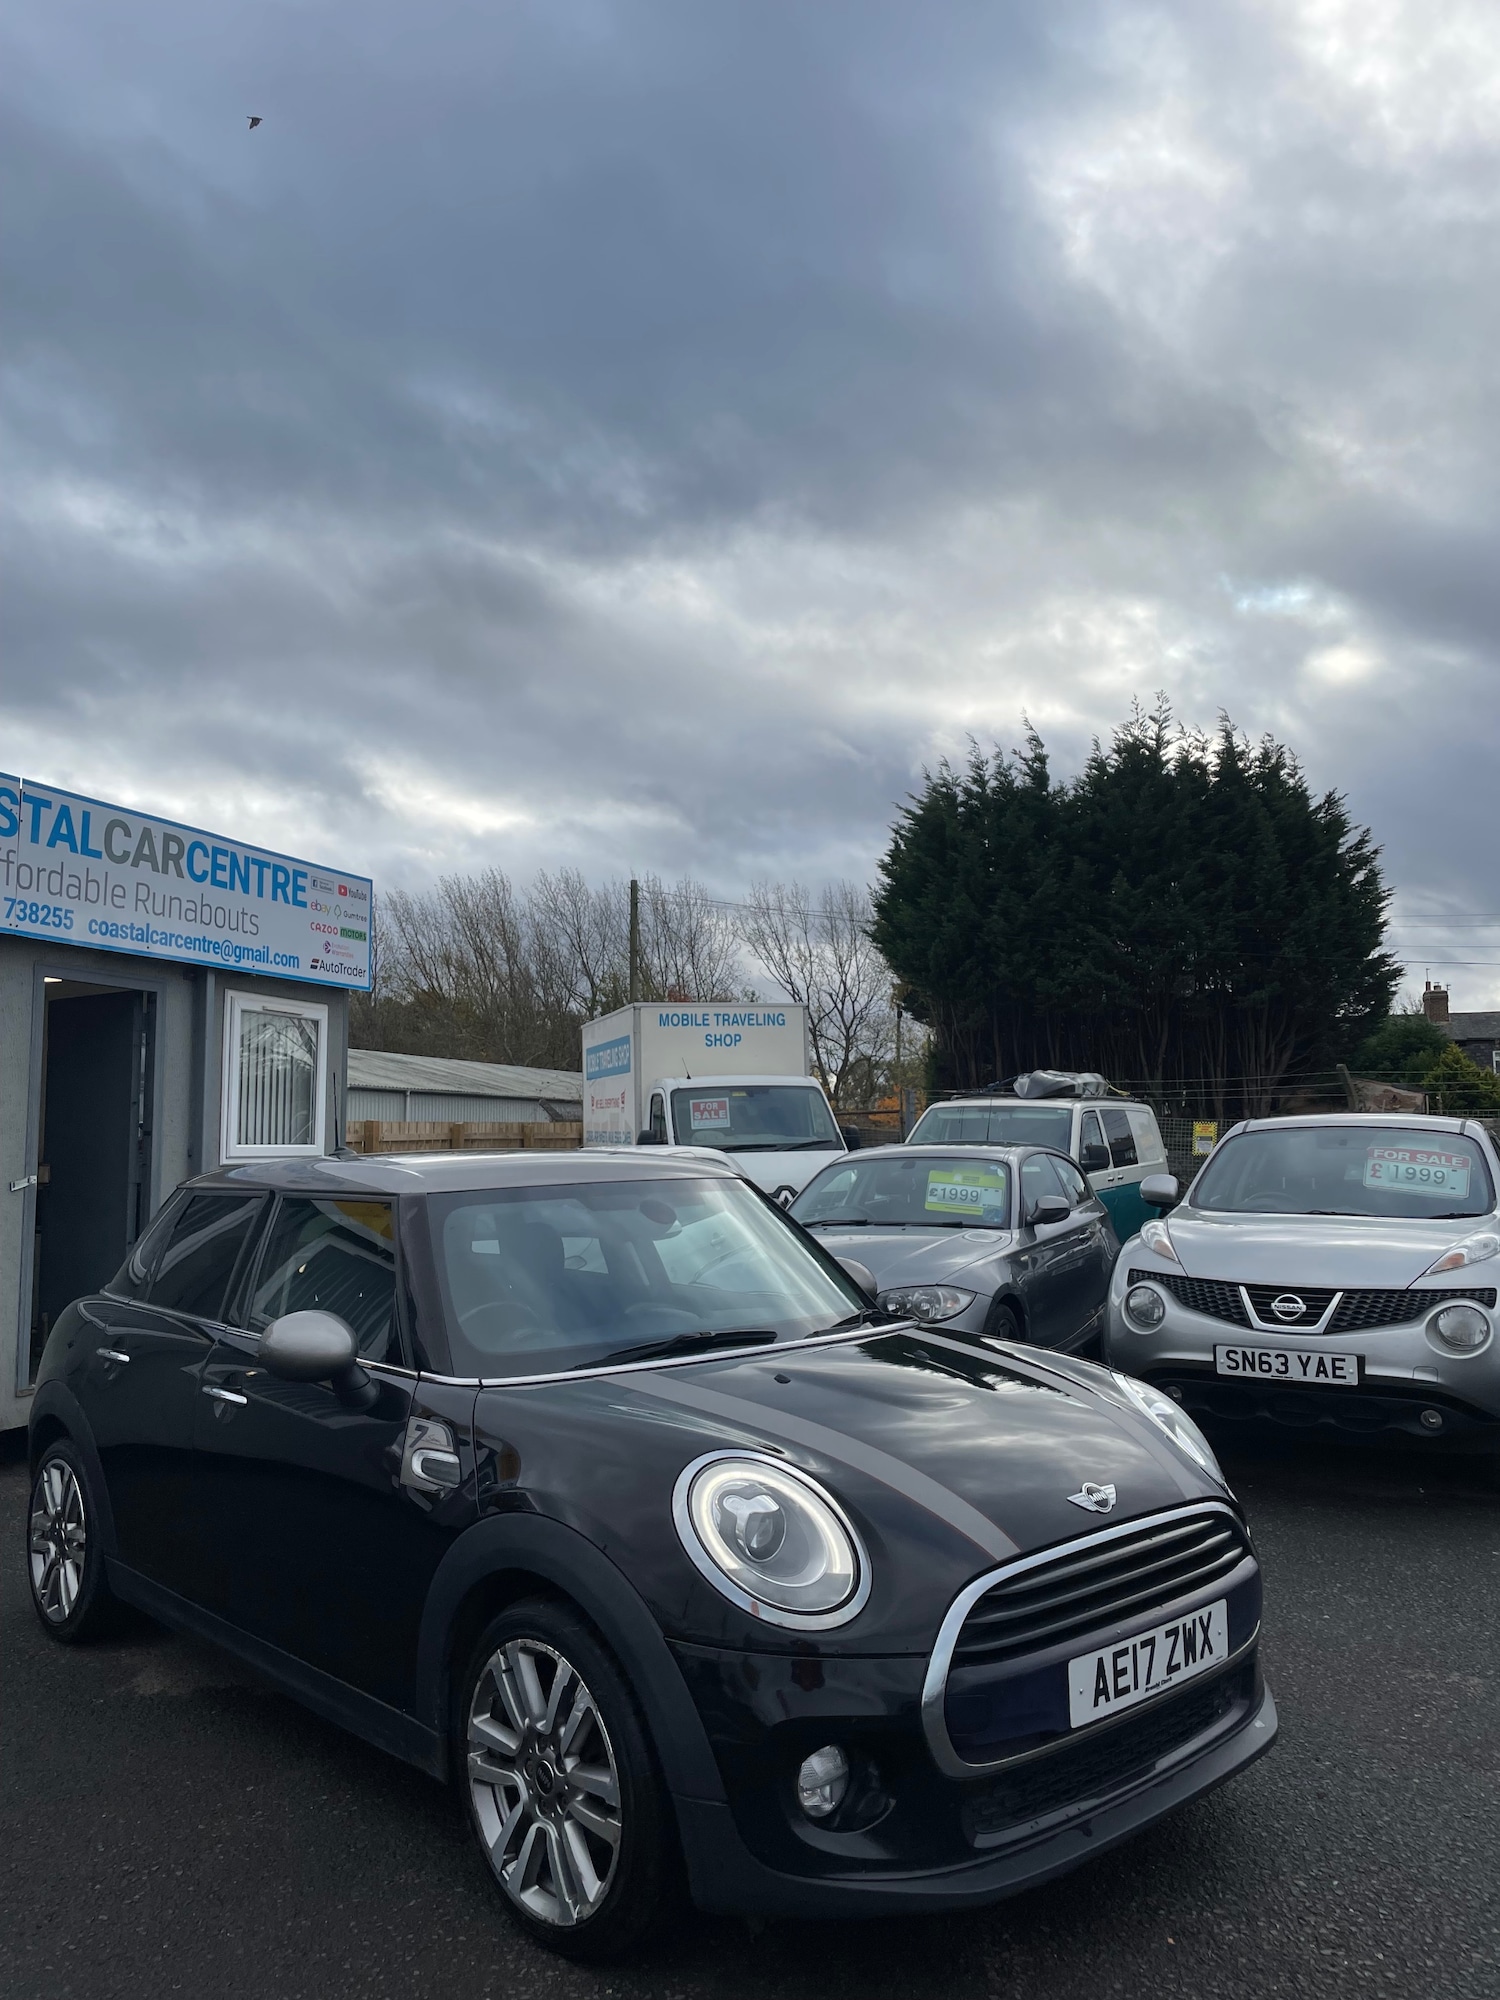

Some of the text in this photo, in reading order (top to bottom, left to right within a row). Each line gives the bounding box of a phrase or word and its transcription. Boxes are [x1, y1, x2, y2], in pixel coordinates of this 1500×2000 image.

[0, 848, 260, 935] fordable Runabouts
[348, 887, 367, 901] YouTube
[310, 899, 331, 917] ebay
[343, 911, 367, 922] Gumtree
[3, 897, 300, 969] 738255 coastalcarcentre@gmail.com
[310, 921, 338, 936] CAZOO
[319, 959, 366, 978] AutoTrader
[659, 1012, 786, 1027] MOBILE TRAVELING
[705, 1033, 742, 1047] SHOP
[700, 1102, 718, 1111] FOR
[694, 1109, 726, 1120] SALE
[1373, 1149, 1464, 1167] FOR SALE
[929, 1187, 979, 1203] £1999
[1225, 1349, 1349, 1380] SN63 YAE
[1088, 1491, 1108, 1503] MINI
[1093, 1611, 1214, 1708] AE17 ZWX
